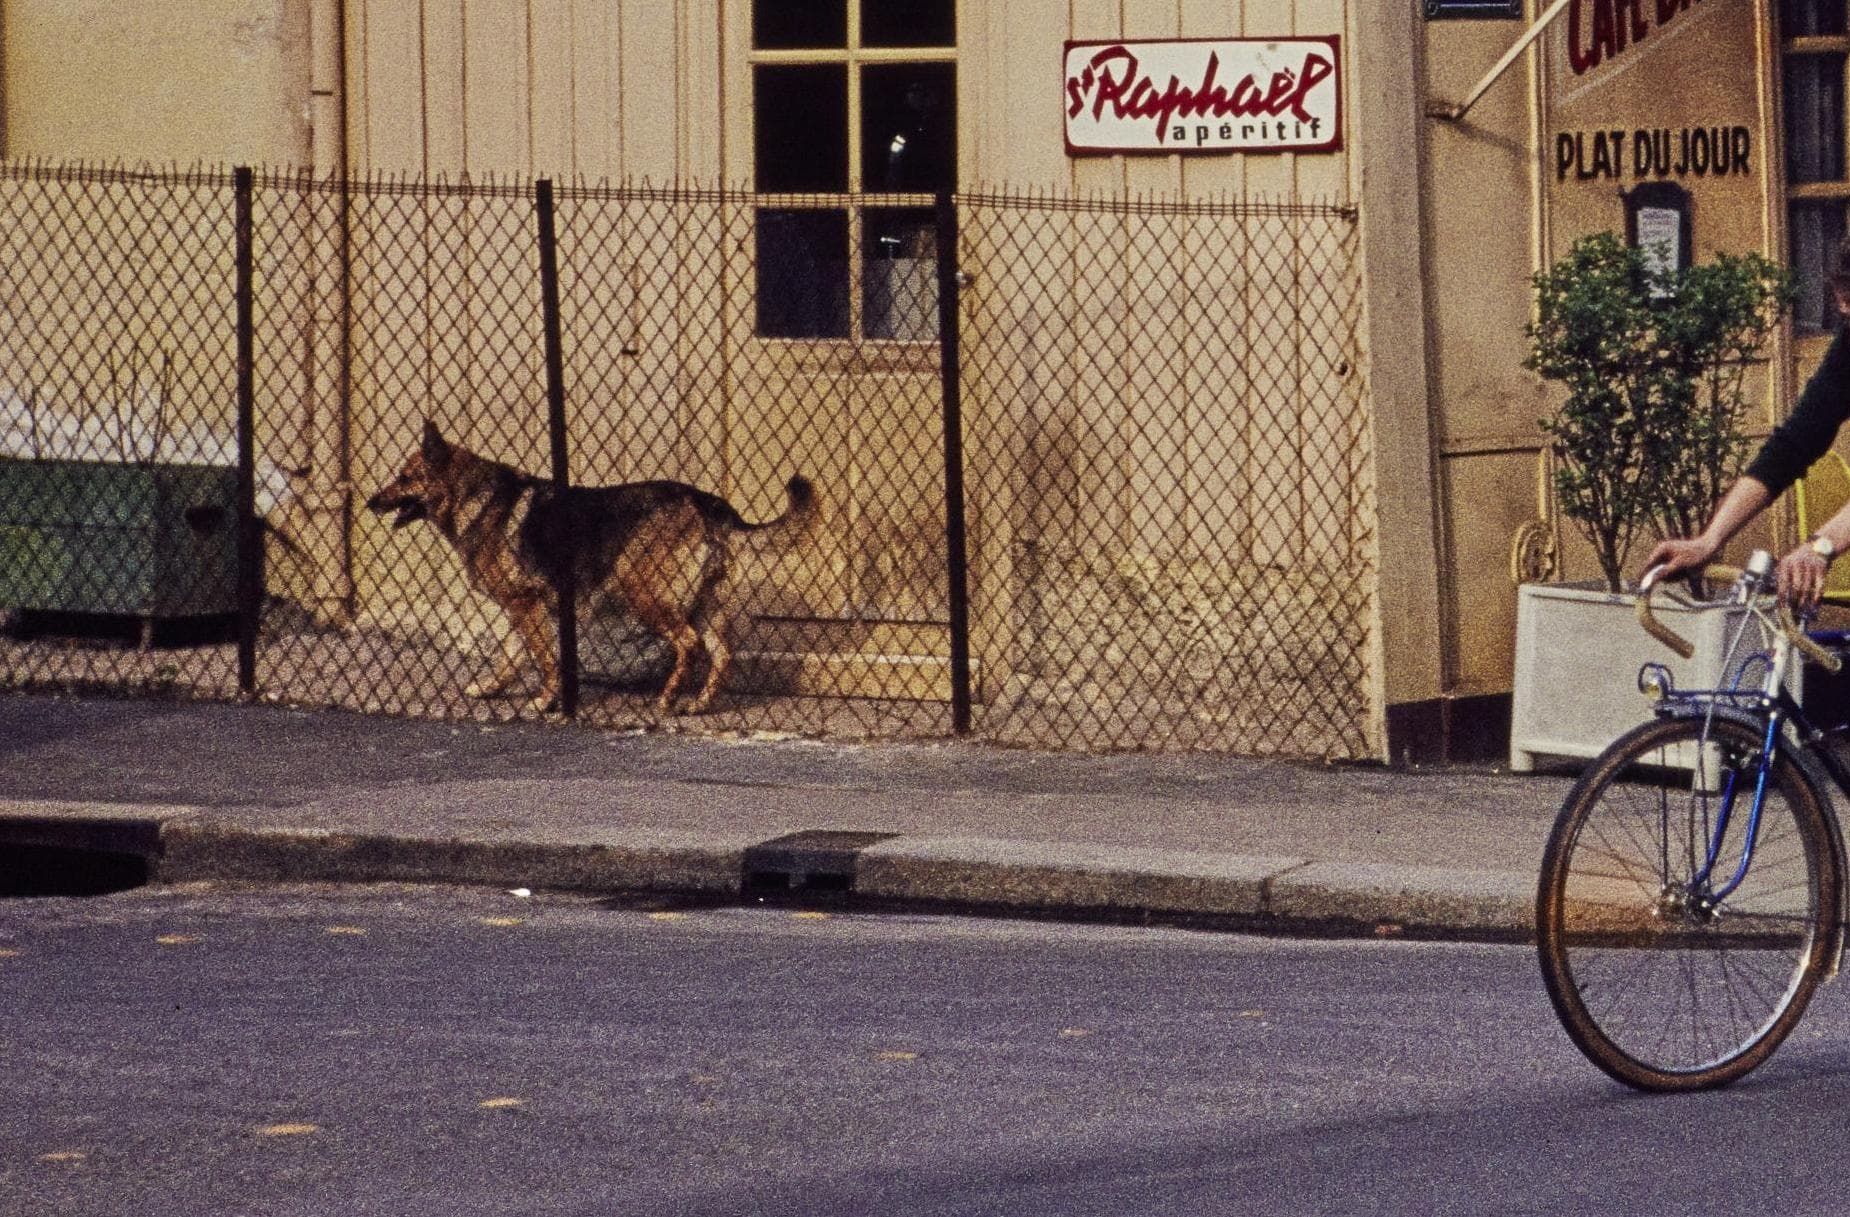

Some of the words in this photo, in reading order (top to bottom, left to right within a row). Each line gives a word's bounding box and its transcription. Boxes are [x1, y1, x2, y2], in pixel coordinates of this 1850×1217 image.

[1091, 45, 1333, 145] Raphaël
[1172, 117, 1321, 146] apéritif
[1557, 131, 1626, 181] PLAT
[1634, 128, 1671, 178] DU
[1674, 125, 1750, 177] JOUR
